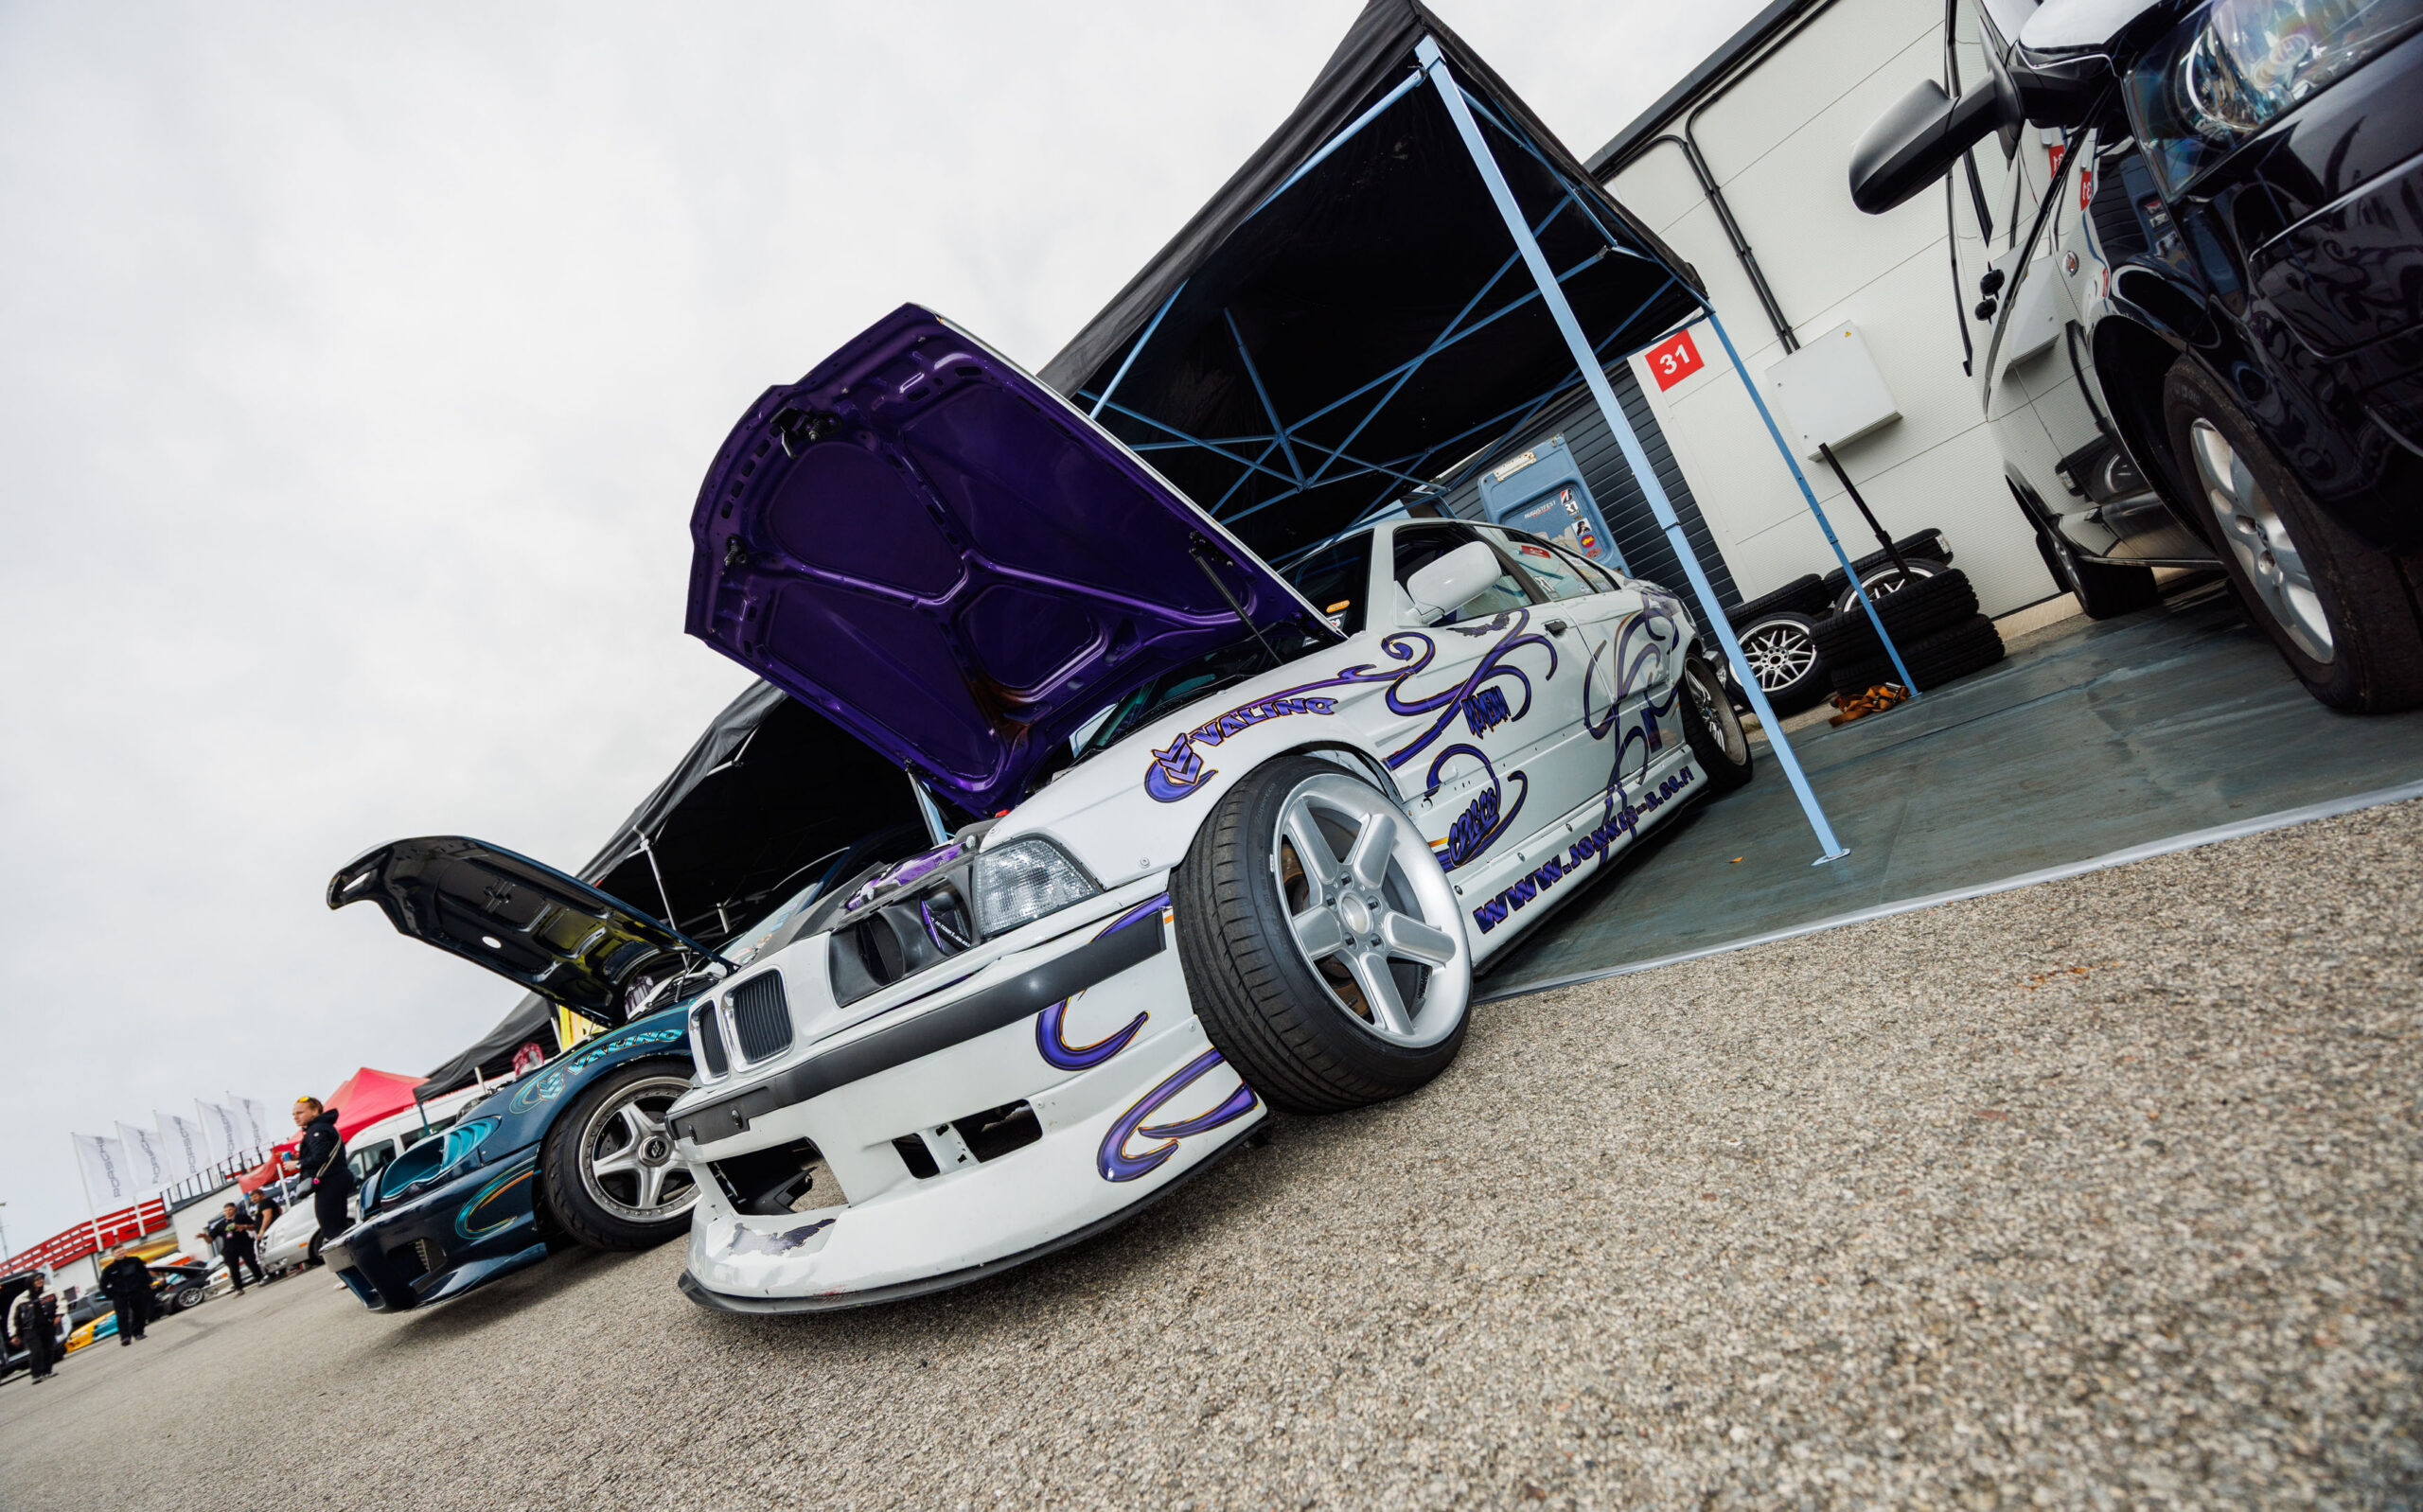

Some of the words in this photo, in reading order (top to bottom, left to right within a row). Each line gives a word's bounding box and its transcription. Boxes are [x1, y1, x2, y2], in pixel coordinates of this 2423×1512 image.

[1659, 343, 1690, 375] 31
[1189, 697, 1338, 747] VALINO
[567, 1029, 686, 1076] VALINO
